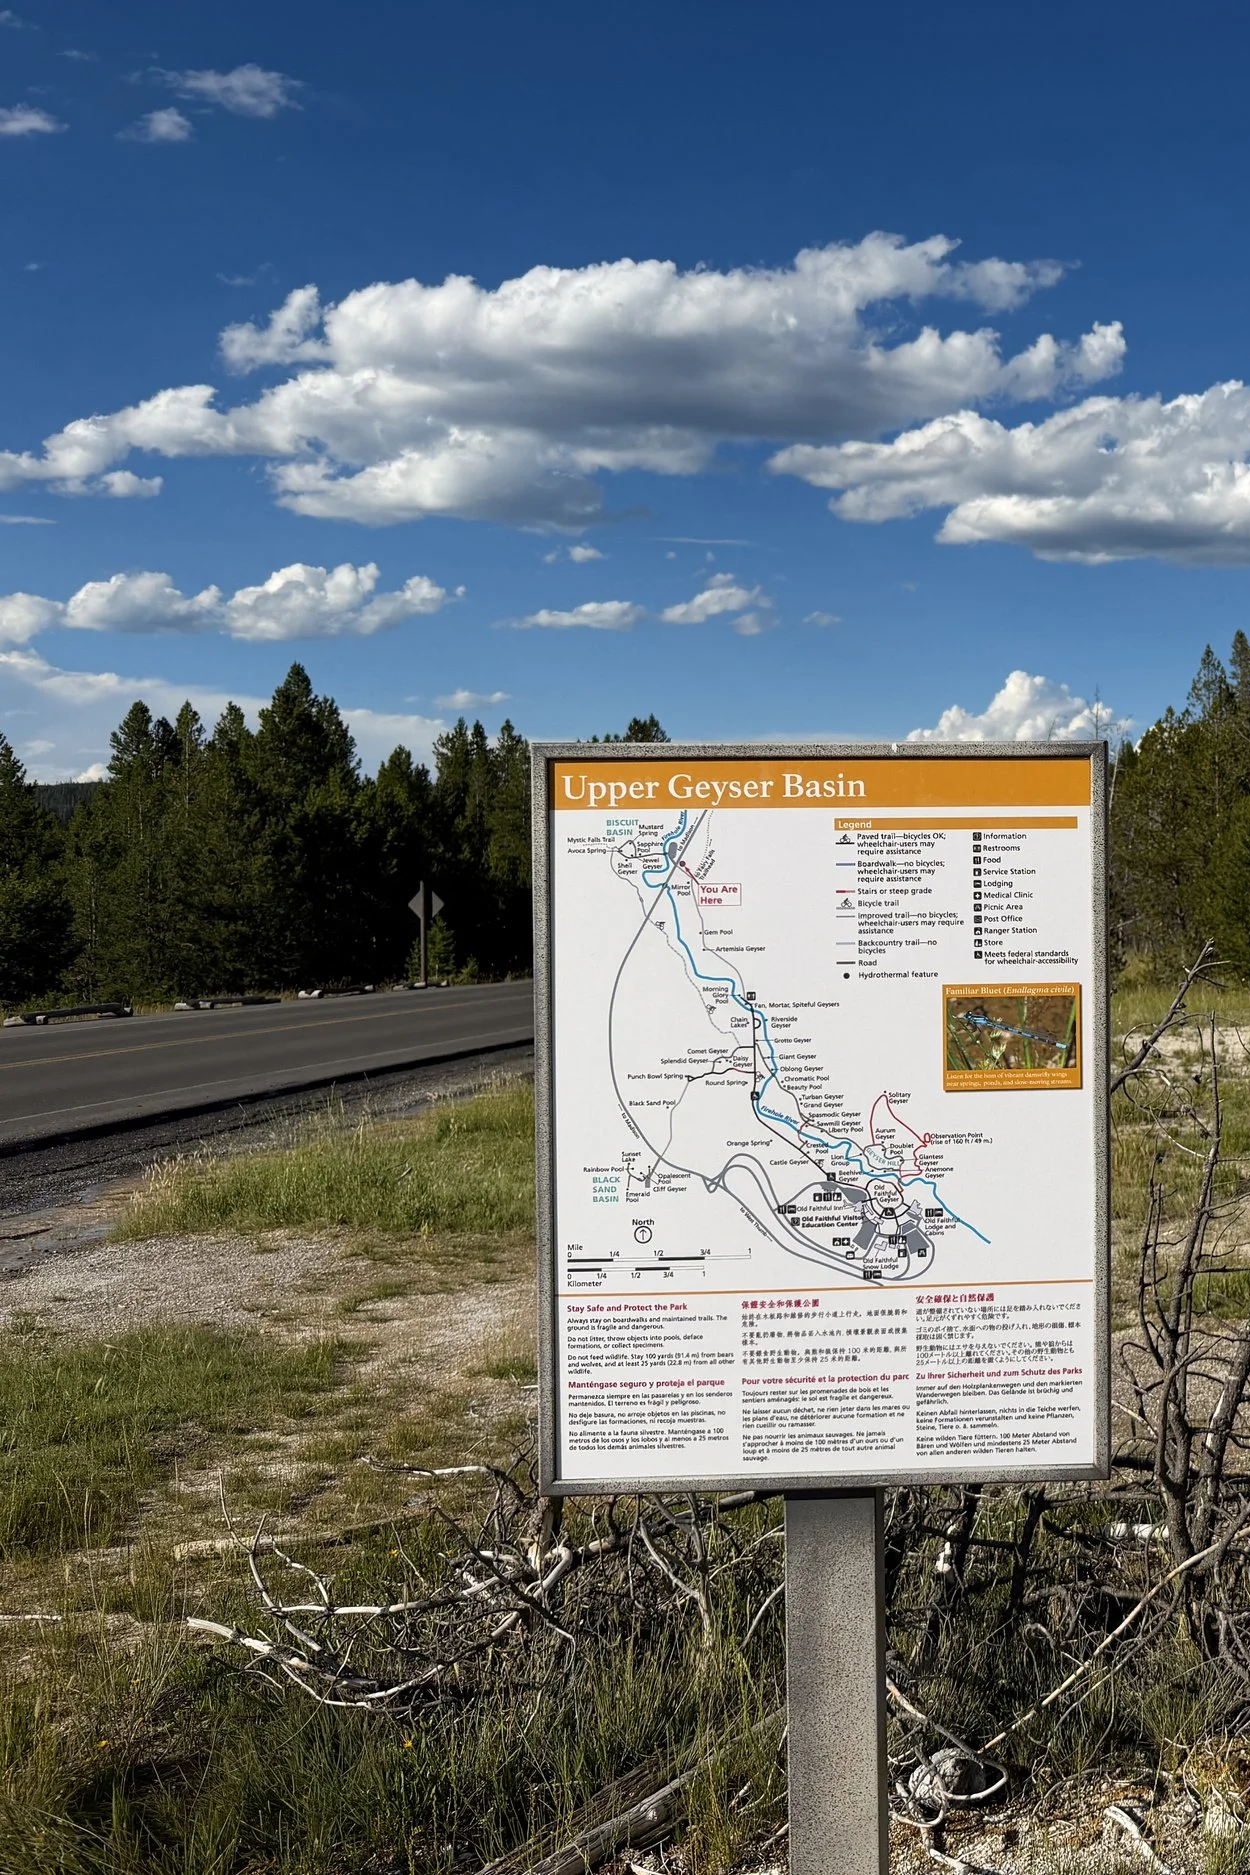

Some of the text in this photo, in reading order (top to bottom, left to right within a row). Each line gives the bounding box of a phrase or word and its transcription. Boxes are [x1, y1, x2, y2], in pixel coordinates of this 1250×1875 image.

[562, 773, 866, 807] Upper Geyser Basin
[605, 818, 640, 827] BISCUIT
[838, 820, 872, 830] Legend
[605, 828, 634, 836] BASIN
[587, 836, 604, 844] Falls
[602, 836, 616, 844] Trail
[857, 840, 918, 848] wheelchair-users
[983, 856, 1001, 864] Food
[857, 876, 885, 884] require
[984, 880, 1013, 889] Lodging
[700, 885, 738, 894] You Are
[889, 888, 909, 896] steep
[910, 887, 933, 896] grade
[1015, 891, 1033, 899] Clinic
[699, 896, 724, 905] Here
[858, 900, 883, 908] Bicycle
[984, 927, 1010, 936] Ranger
[715, 945, 766, 953] Artemisia Geyser
[858, 947, 886, 955] bicycles
[983, 949, 1070, 958] Meets federal standards
[858, 959, 878, 967] Road
[997, 957, 1079, 965] wheelchair-accessibility
[859, 971, 910, 980] Hydrothermal
[945, 987, 979, 995] Familiar
[1003, 986, 1049, 995] (Enallagma
[1049, 986, 1075, 994] civile)
[591, 1175, 622, 1184] BLACK
[591, 1185, 617, 1194] SAND
[591, 1195, 619, 1204] BASIN
[632, 1218, 656, 1226] North
[653, 1249, 665, 1257] 1/2
[699, 1248, 712, 1256] 3/4
[596, 1272, 608, 1280] 1/4
[630, 1271, 642, 1279] 1/2
[663, 1271, 674, 1279] 3/4
[566, 1280, 603, 1288] Kilometer
[914, 1293, 996, 1305] 安全確保と自然保護
[567, 1305, 585, 1313] Stay
[587, 1304, 605, 1312] Safe
[606, 1304, 622, 1312] and
[624, 1304, 652, 1312] Protect
[670, 1303, 688, 1311] Park
[947, 1371, 985, 1379] Sicherheit
[1003, 1369, 1019, 1377] zum
[1062, 1367, 1083, 1375] Parks
[785, 1376, 816, 1384] sécurité
[837, 1374, 878, 1384] protection
[880, 1373, 891, 1381] du
[892, 1374, 910, 1382] parc
[568, 1381, 618, 1389] Manténgase
[619, 1380, 647, 1389] seguro
[656, 1380, 685, 1388] proteja
